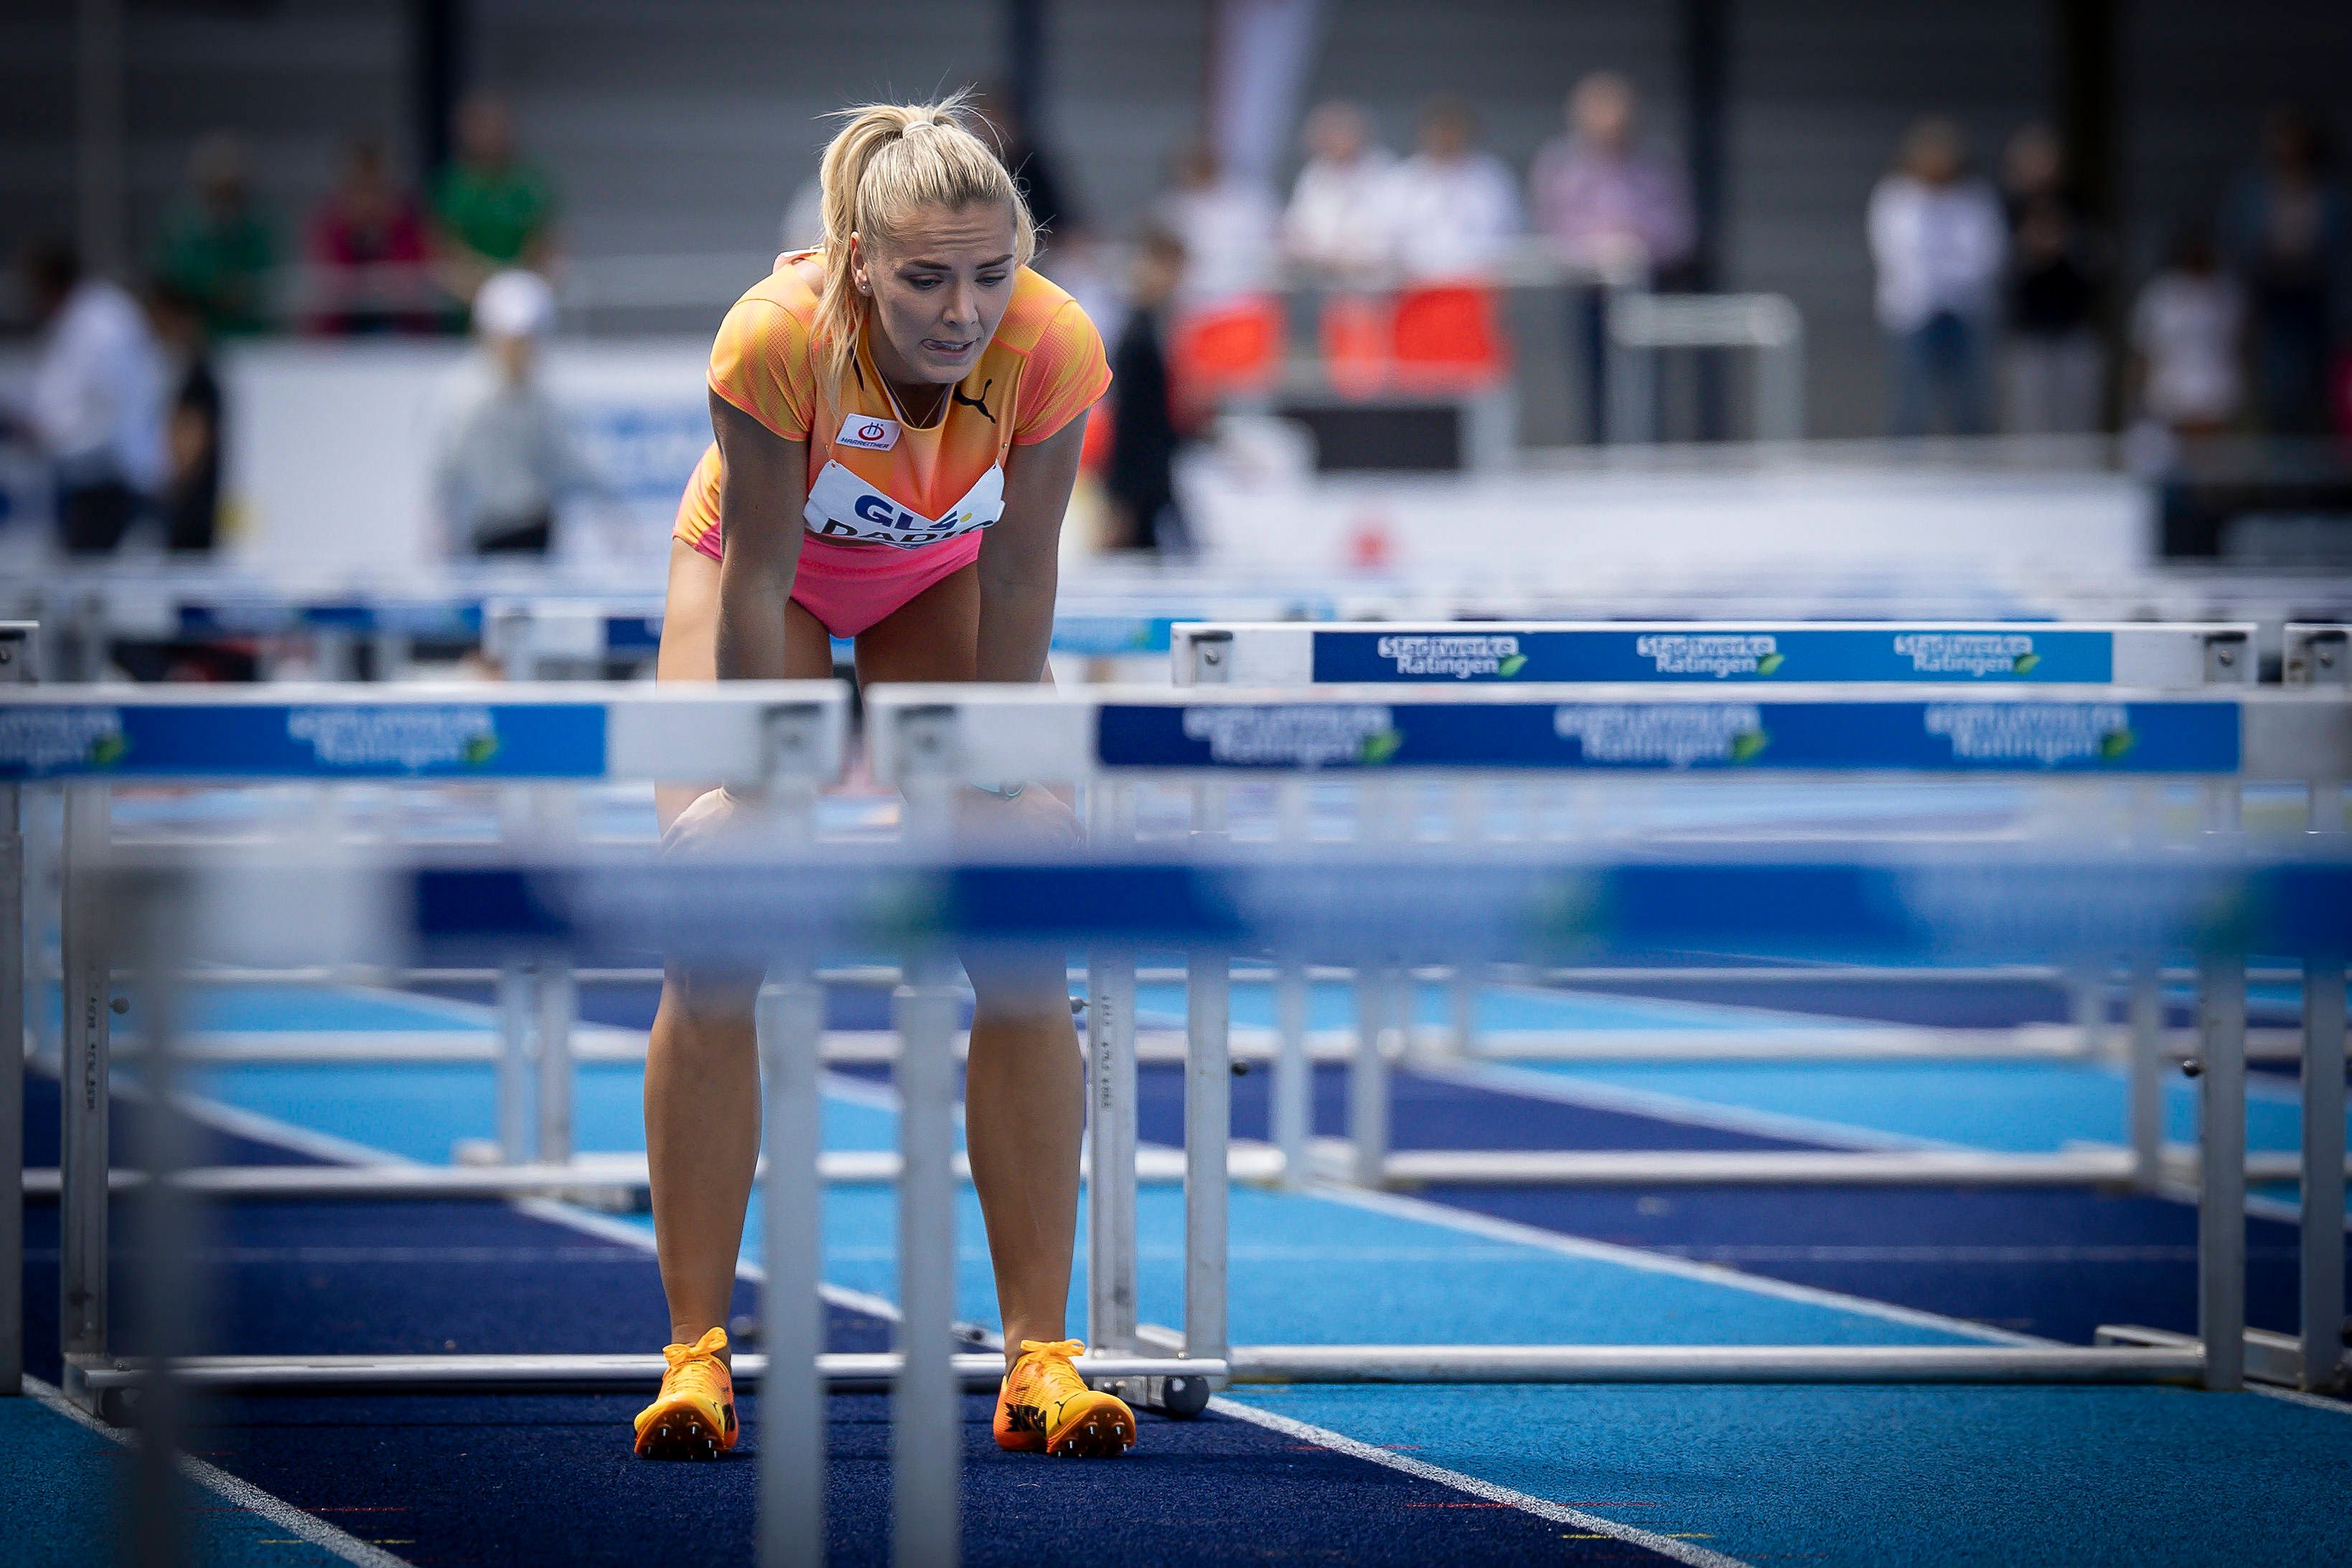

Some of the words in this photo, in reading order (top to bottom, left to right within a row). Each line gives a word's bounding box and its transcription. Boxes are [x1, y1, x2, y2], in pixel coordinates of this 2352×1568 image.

[854, 494, 958, 531] GLS
[1397, 654, 1499, 679] Ratingen
[1656, 654, 1758, 678] Ratingen
[1913, 652, 2013, 677] Ratingen
